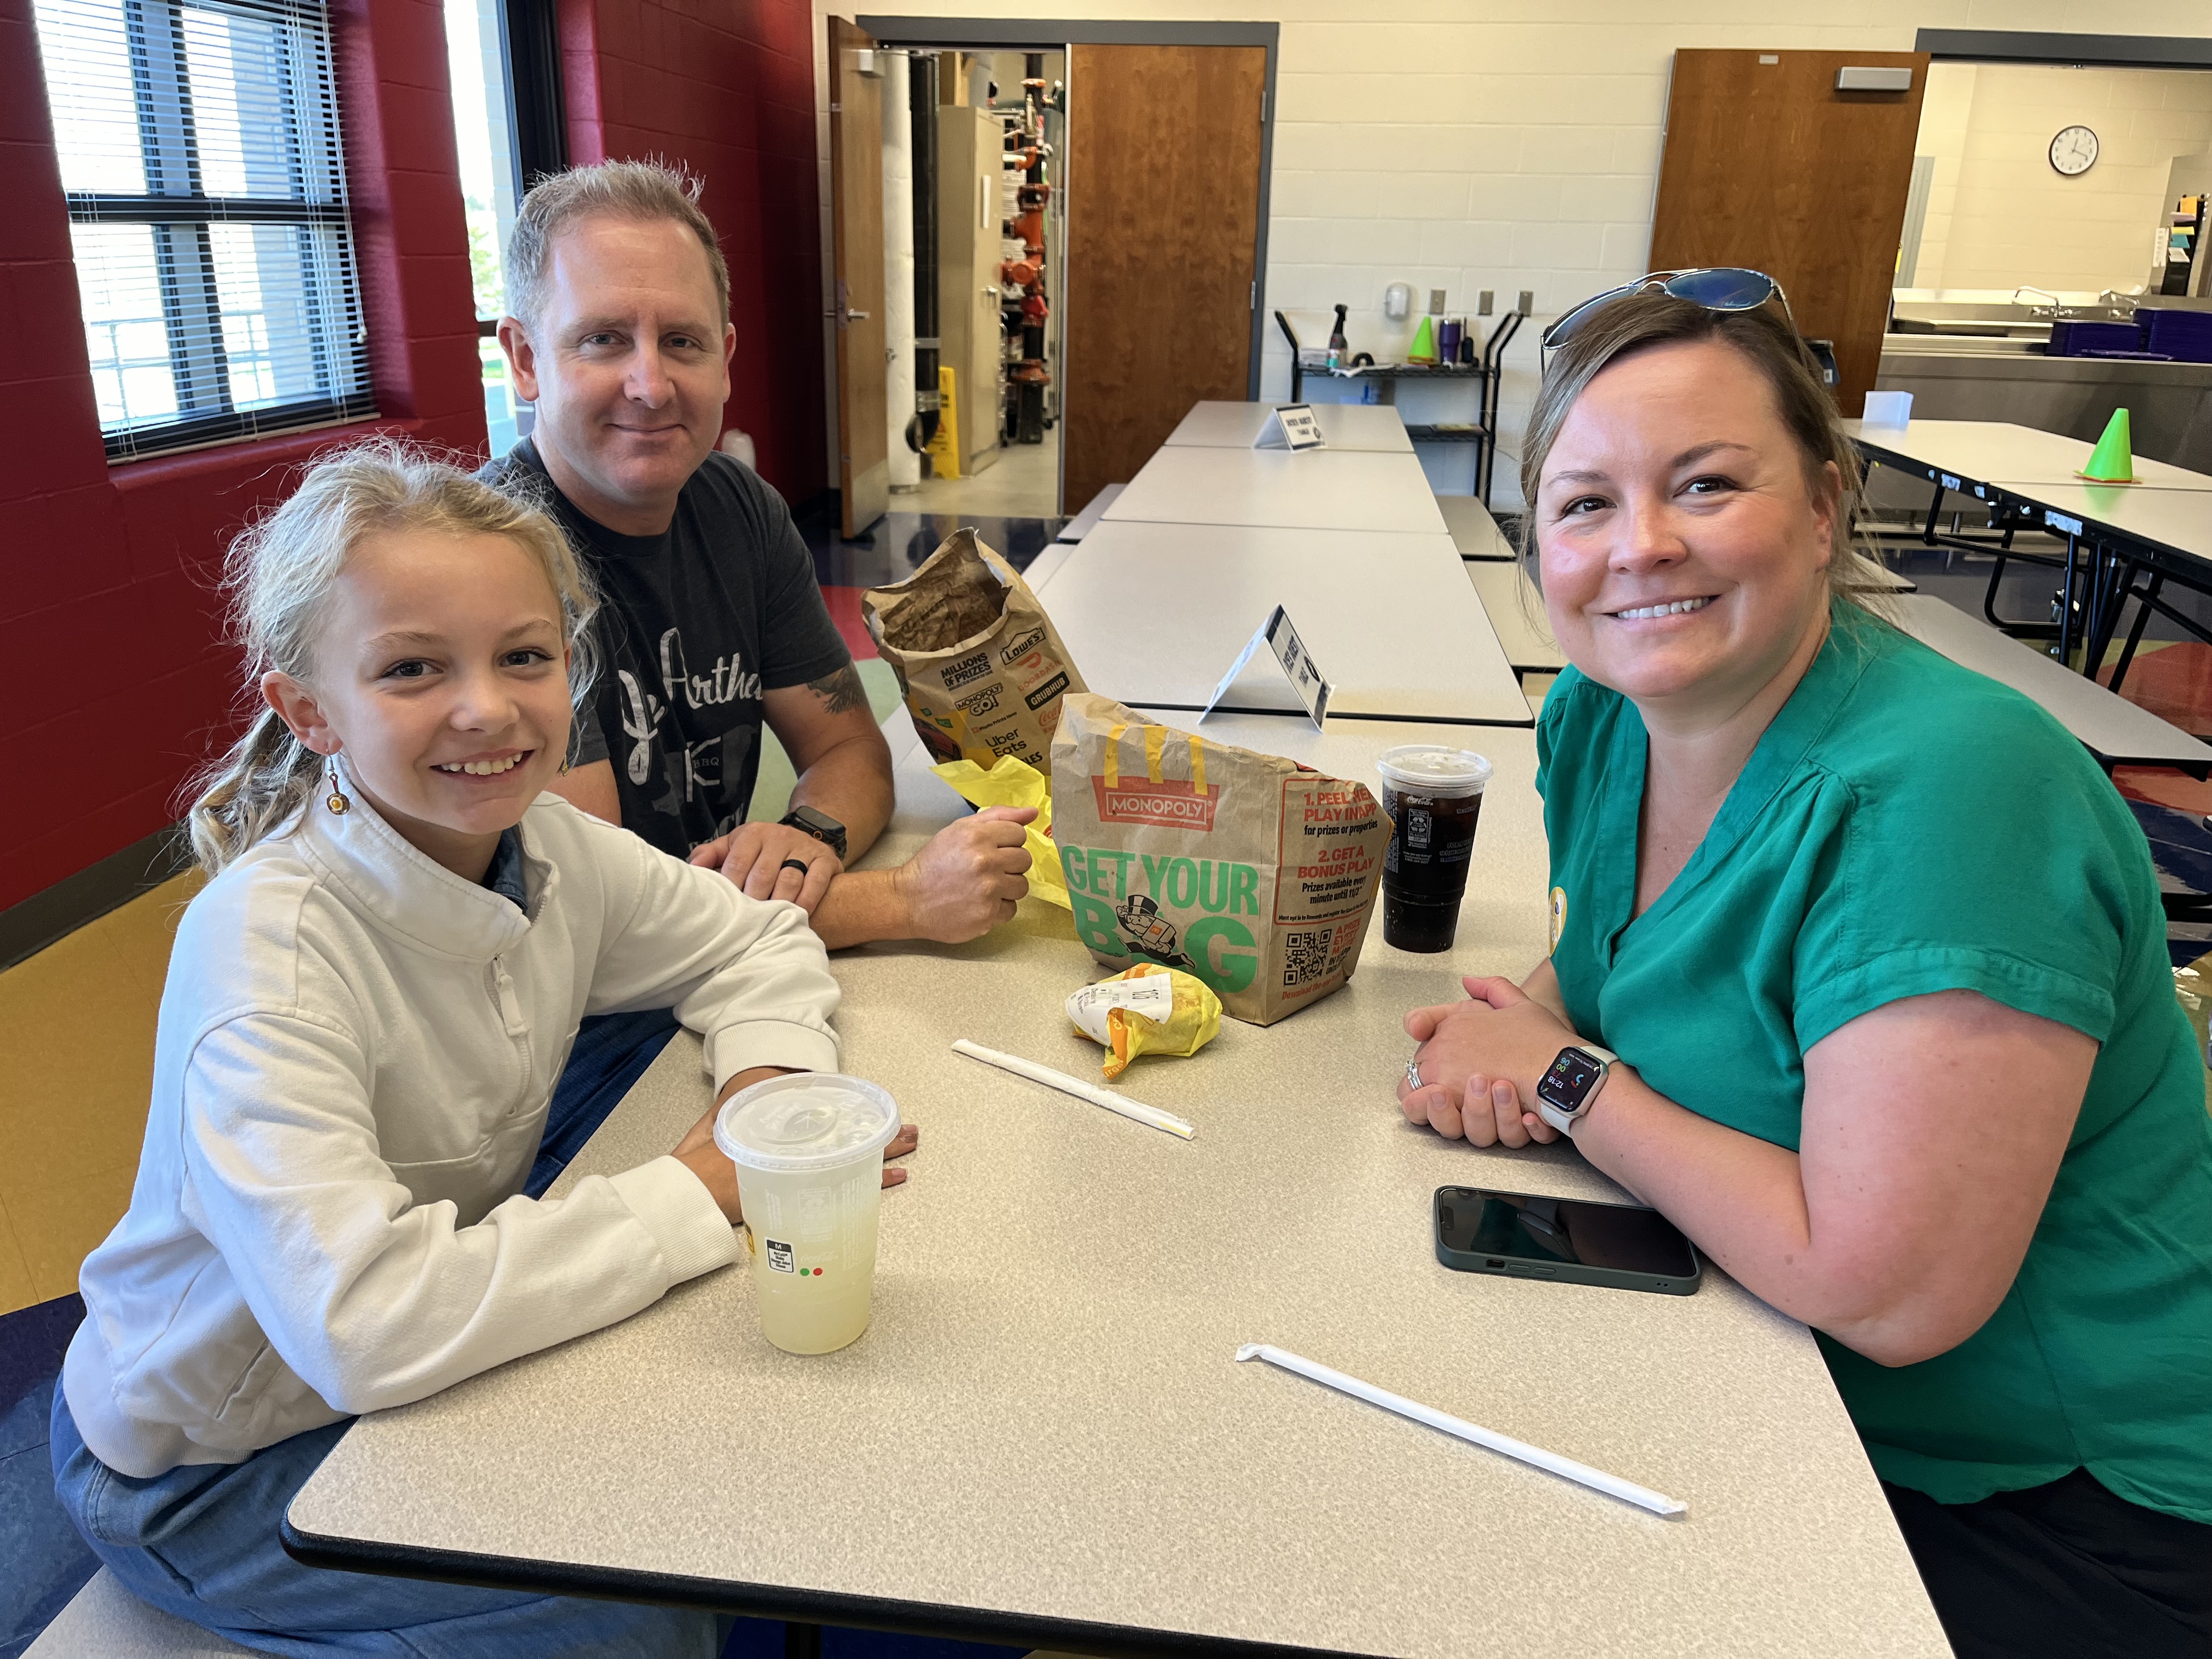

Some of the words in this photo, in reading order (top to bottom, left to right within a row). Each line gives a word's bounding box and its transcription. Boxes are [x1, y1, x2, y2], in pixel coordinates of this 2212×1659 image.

[1005, 633, 1040, 661] LOWE'S
[941, 652, 988, 679] MILLIONS
[944, 676, 954, 687] OF
[955, 661, 991, 682] PRIZES
[1018, 658, 1062, 691] DOORDASH
[957, 686, 999, 709] MONOPOLY
[1031, 677, 1065, 706] GRUBHUB
[969, 695, 999, 716] GO!
[985, 729, 1019, 747] Uber
[992, 740, 1027, 758] Eats
[1020, 751, 1043, 765] LES
[693, 757, 719, 769] BBQ
[1317, 791, 1350, 805] PEEL
[1353, 787, 1374, 804] HE
[1112, 797, 1202, 817] MONOPOLY
[1304, 808, 1343, 822] PLAY
[1304, 825, 1316, 836] for
[1317, 825, 1339, 838] prizes
[1341, 826, 1349, 834] or
[1349, 819, 1378, 836] properties
[1318, 850, 1330, 863] 2.
[1331, 846, 1356, 861] GET
[1356, 845, 1364, 857] A
[1297, 863, 1345, 878] BONUS
[1346, 857, 1374, 873] PLAY
[1062, 845, 1136, 900] GET
[1141, 854, 1259, 916] YOUR
[1302, 882, 1324, 892] Prizes
[1325, 877, 1352, 890] available
[1353, 876, 1367, 885] every
[1310, 892, 1333, 904] minute
[1334, 890, 1348, 901] until
[1282, 984, 1312, 1000] Download
[1548, 1076, 1564, 1089] 12:18
